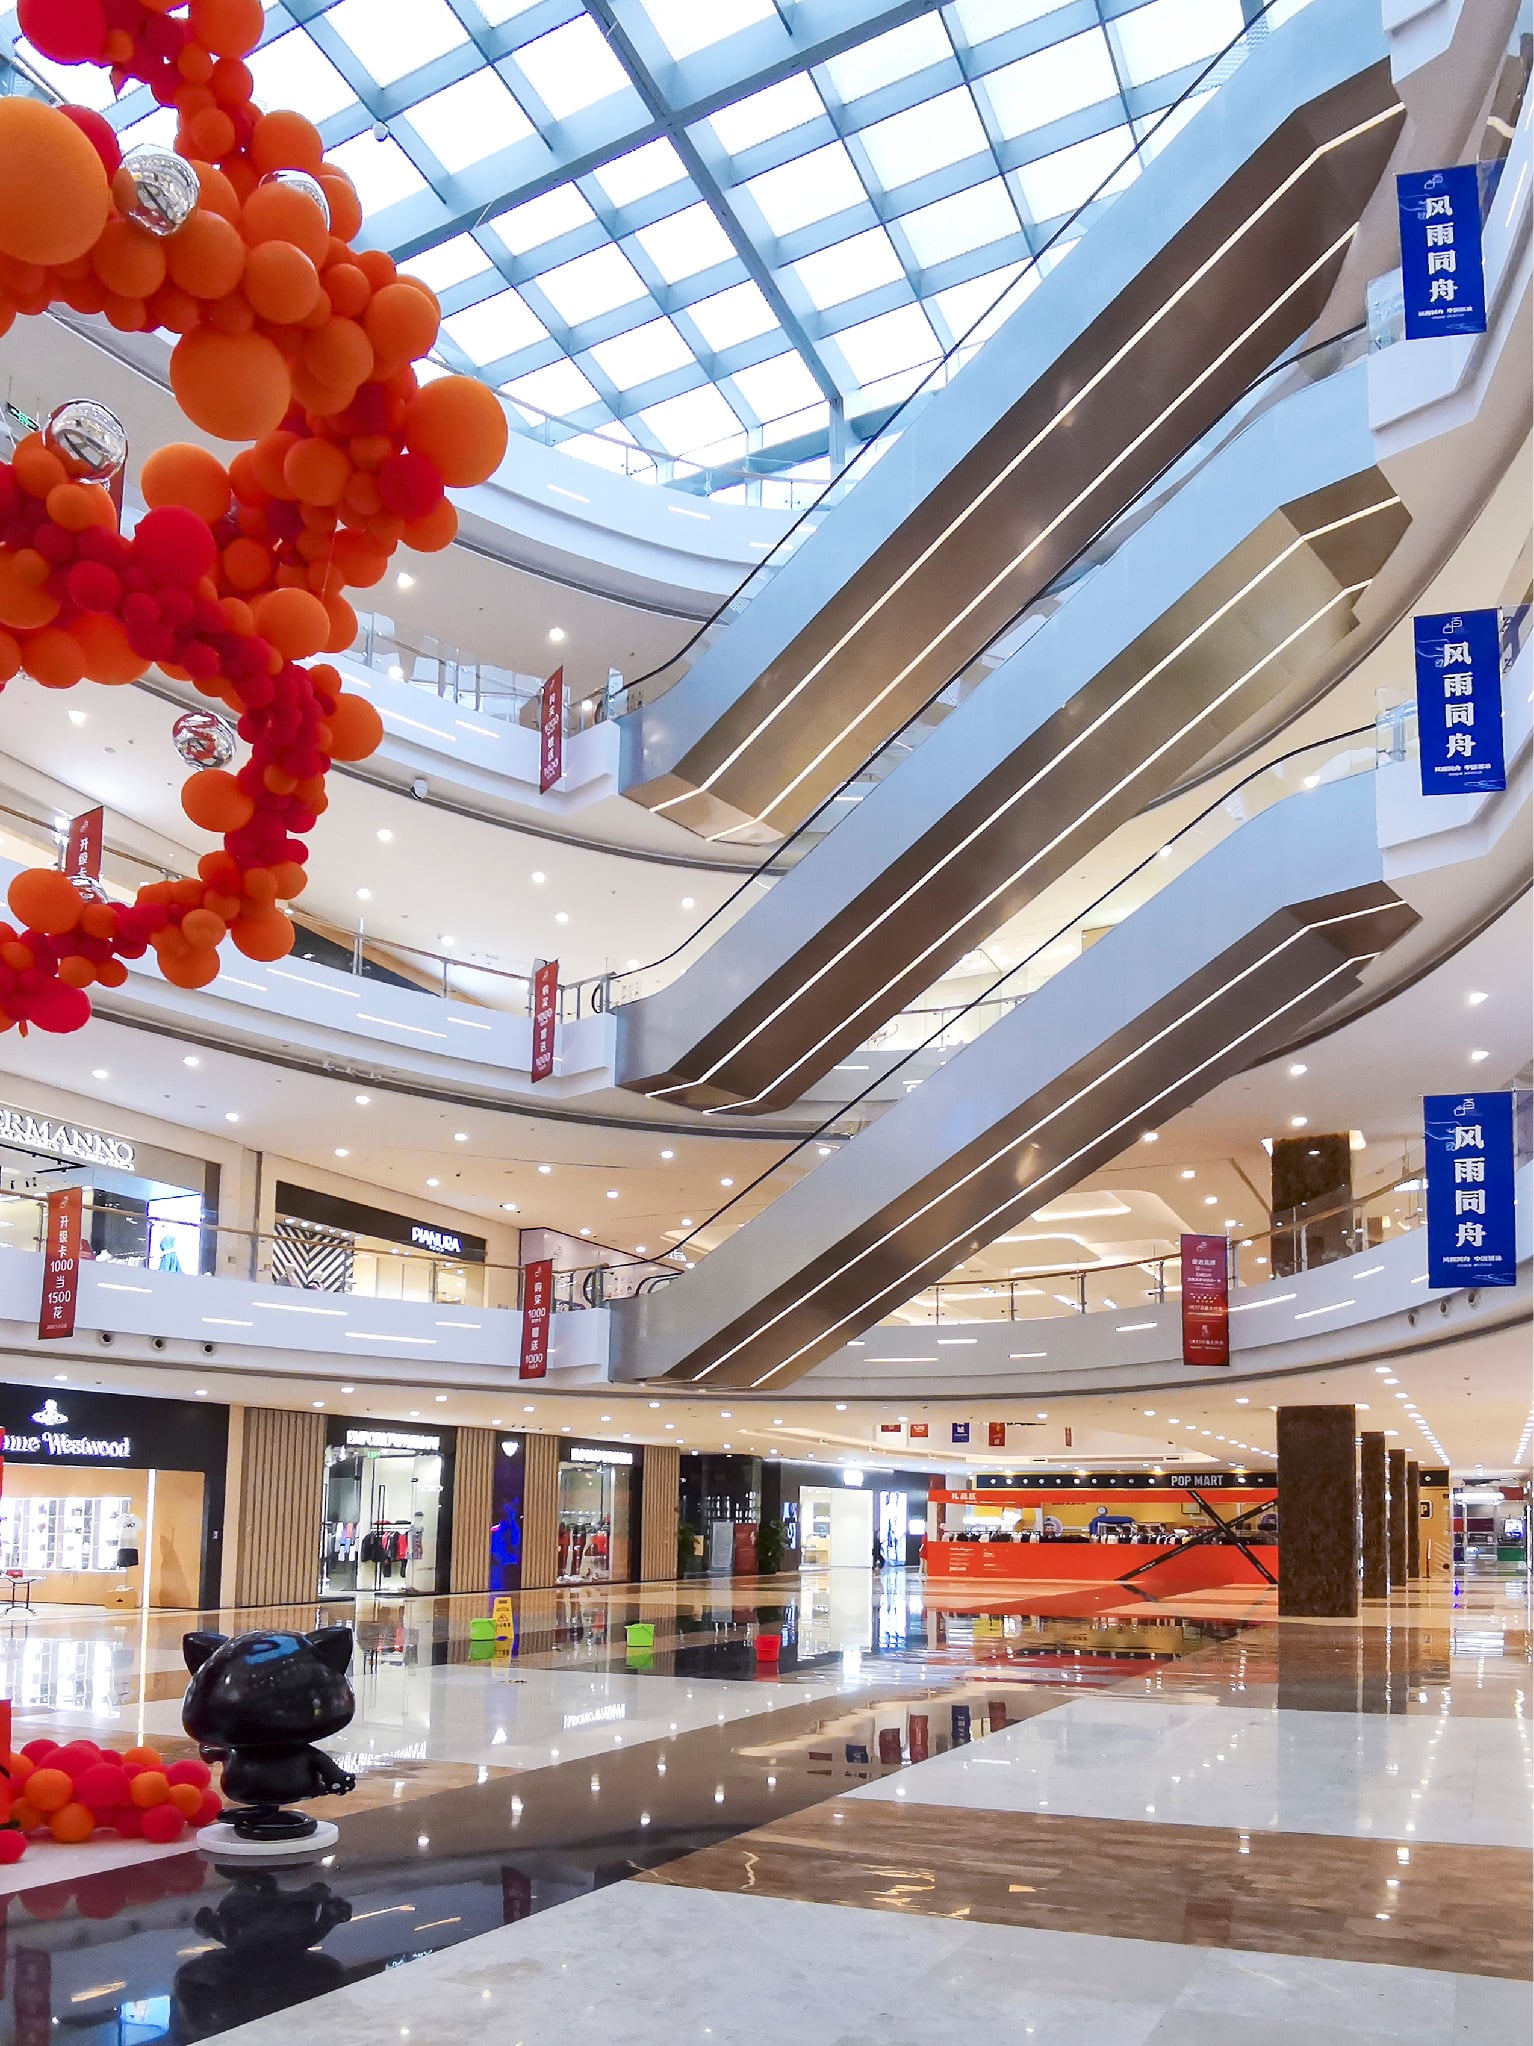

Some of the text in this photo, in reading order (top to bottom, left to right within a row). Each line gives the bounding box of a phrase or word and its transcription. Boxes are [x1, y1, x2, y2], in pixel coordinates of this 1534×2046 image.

[1425, 194, 1458, 303] 风雨同舟
[1442, 640, 1476, 759] 风雨同舟
[0, 1109, 135, 1163] RMANNO
[1453, 1124, 1488, 1248] 风雨同舟
[50, 1258, 73, 1273] 1000
[48, 1290, 71, 1305] 1500
[42, 1431, 131, 1457] Westwood
[1171, 1475, 1223, 1487] POP MART
